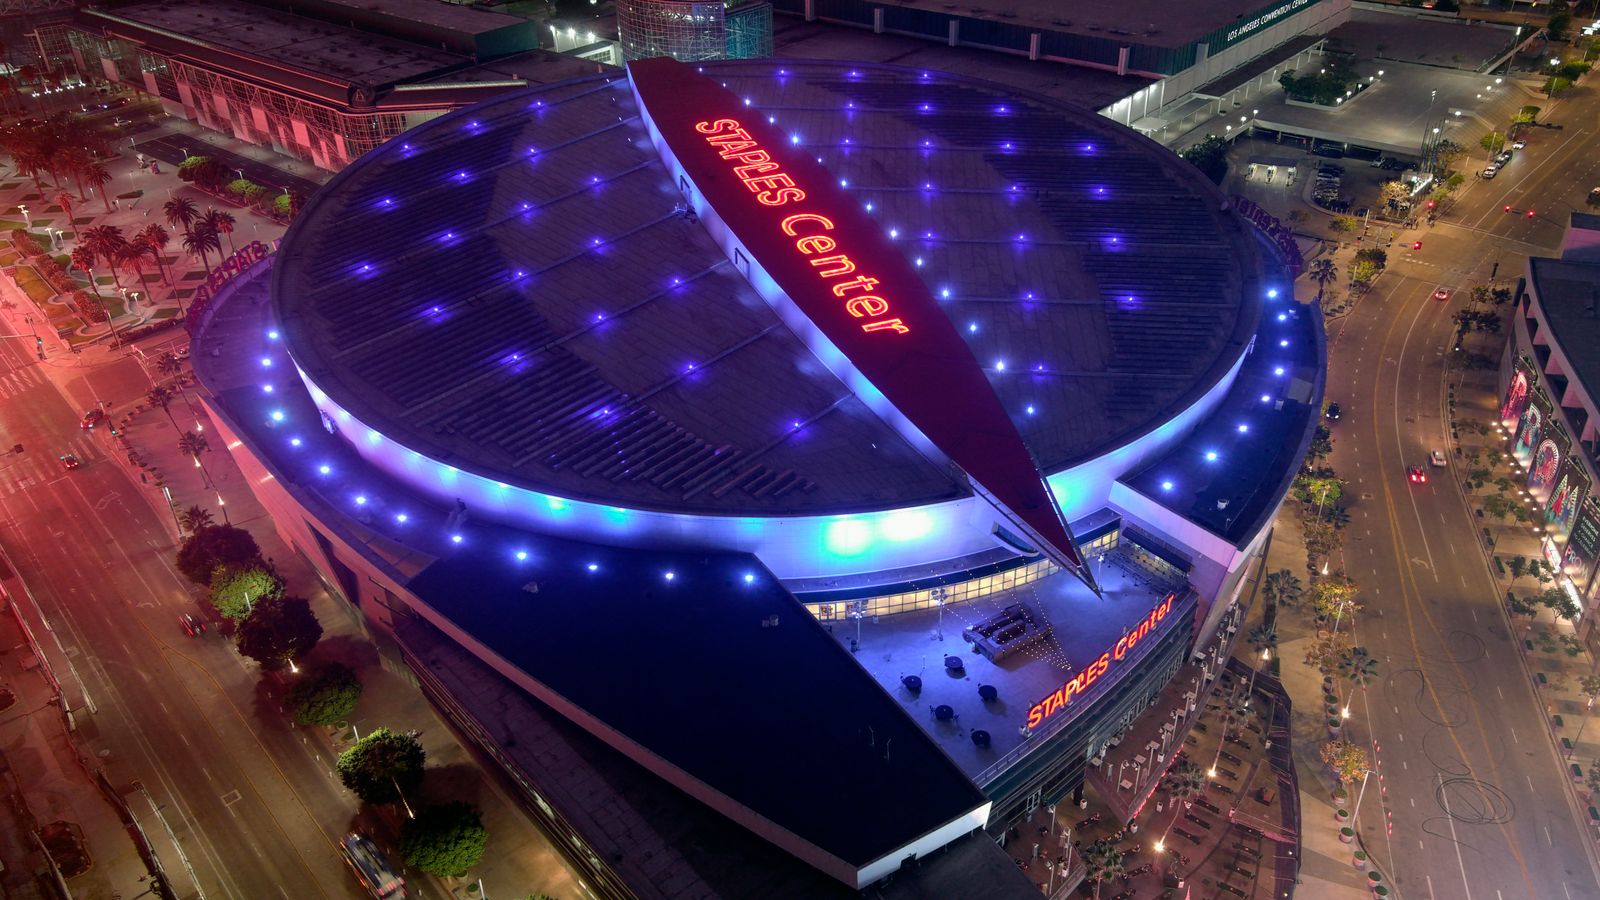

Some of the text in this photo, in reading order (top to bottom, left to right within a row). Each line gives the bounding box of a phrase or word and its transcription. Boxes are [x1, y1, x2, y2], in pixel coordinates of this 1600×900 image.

[1227, 0, 1308, 41] LOS ANGELES CONVENTION CENT
[695, 118, 910, 334] STAPLES Center
[1565, 543, 1589, 579] PROM
[1027, 592, 1176, 729] STAPLES Center
